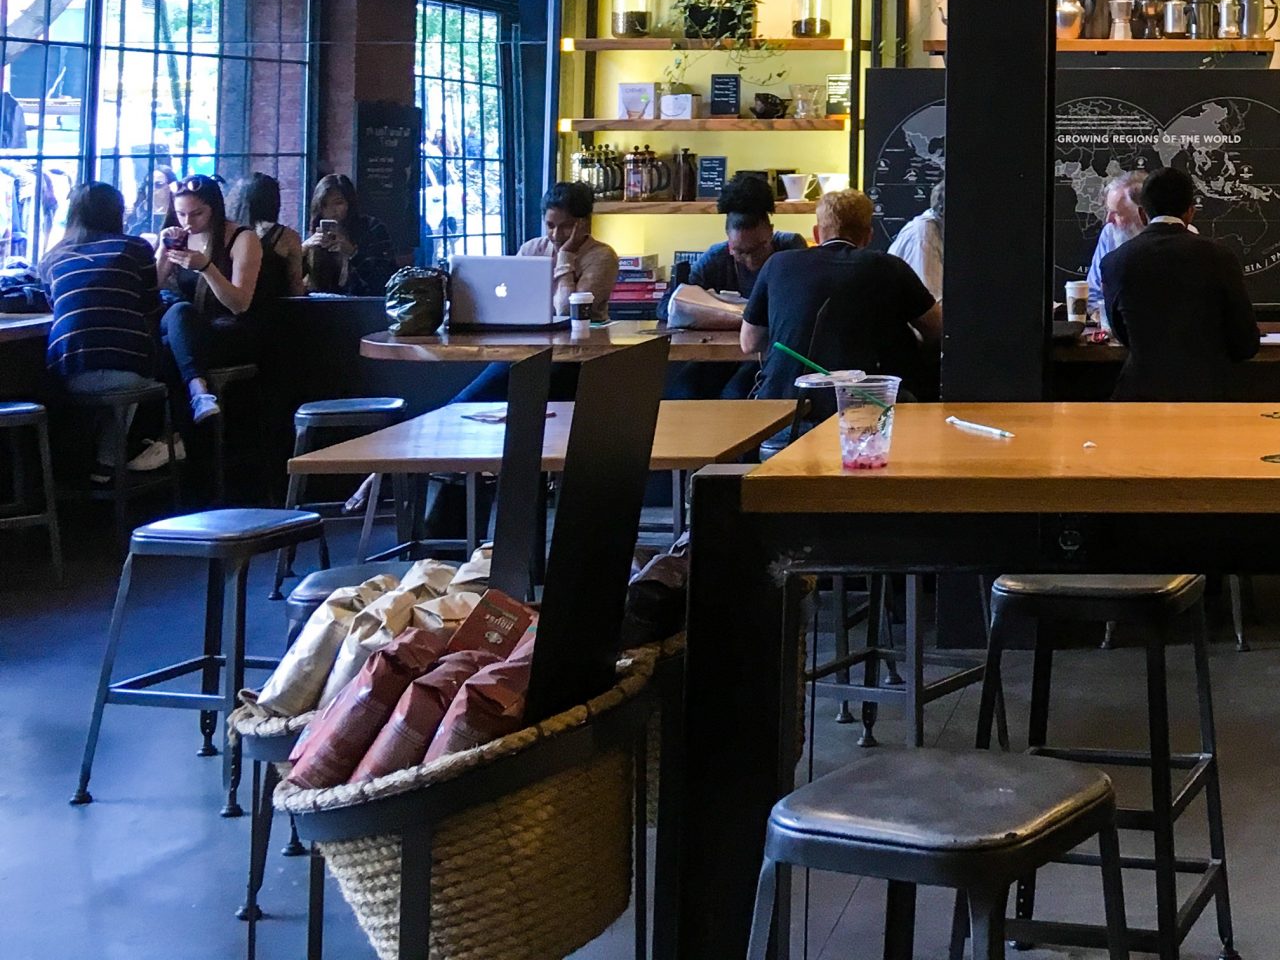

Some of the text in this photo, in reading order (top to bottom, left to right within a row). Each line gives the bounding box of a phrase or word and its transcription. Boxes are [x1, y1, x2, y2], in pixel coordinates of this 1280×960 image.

[1112, 134, 1159, 144] REGIONS
[1162, 134, 1177, 144] OF
[1180, 134, 1200, 144] THE
[1203, 134, 1242, 144] WORLD
[1244, 262, 1262, 272] SIA
